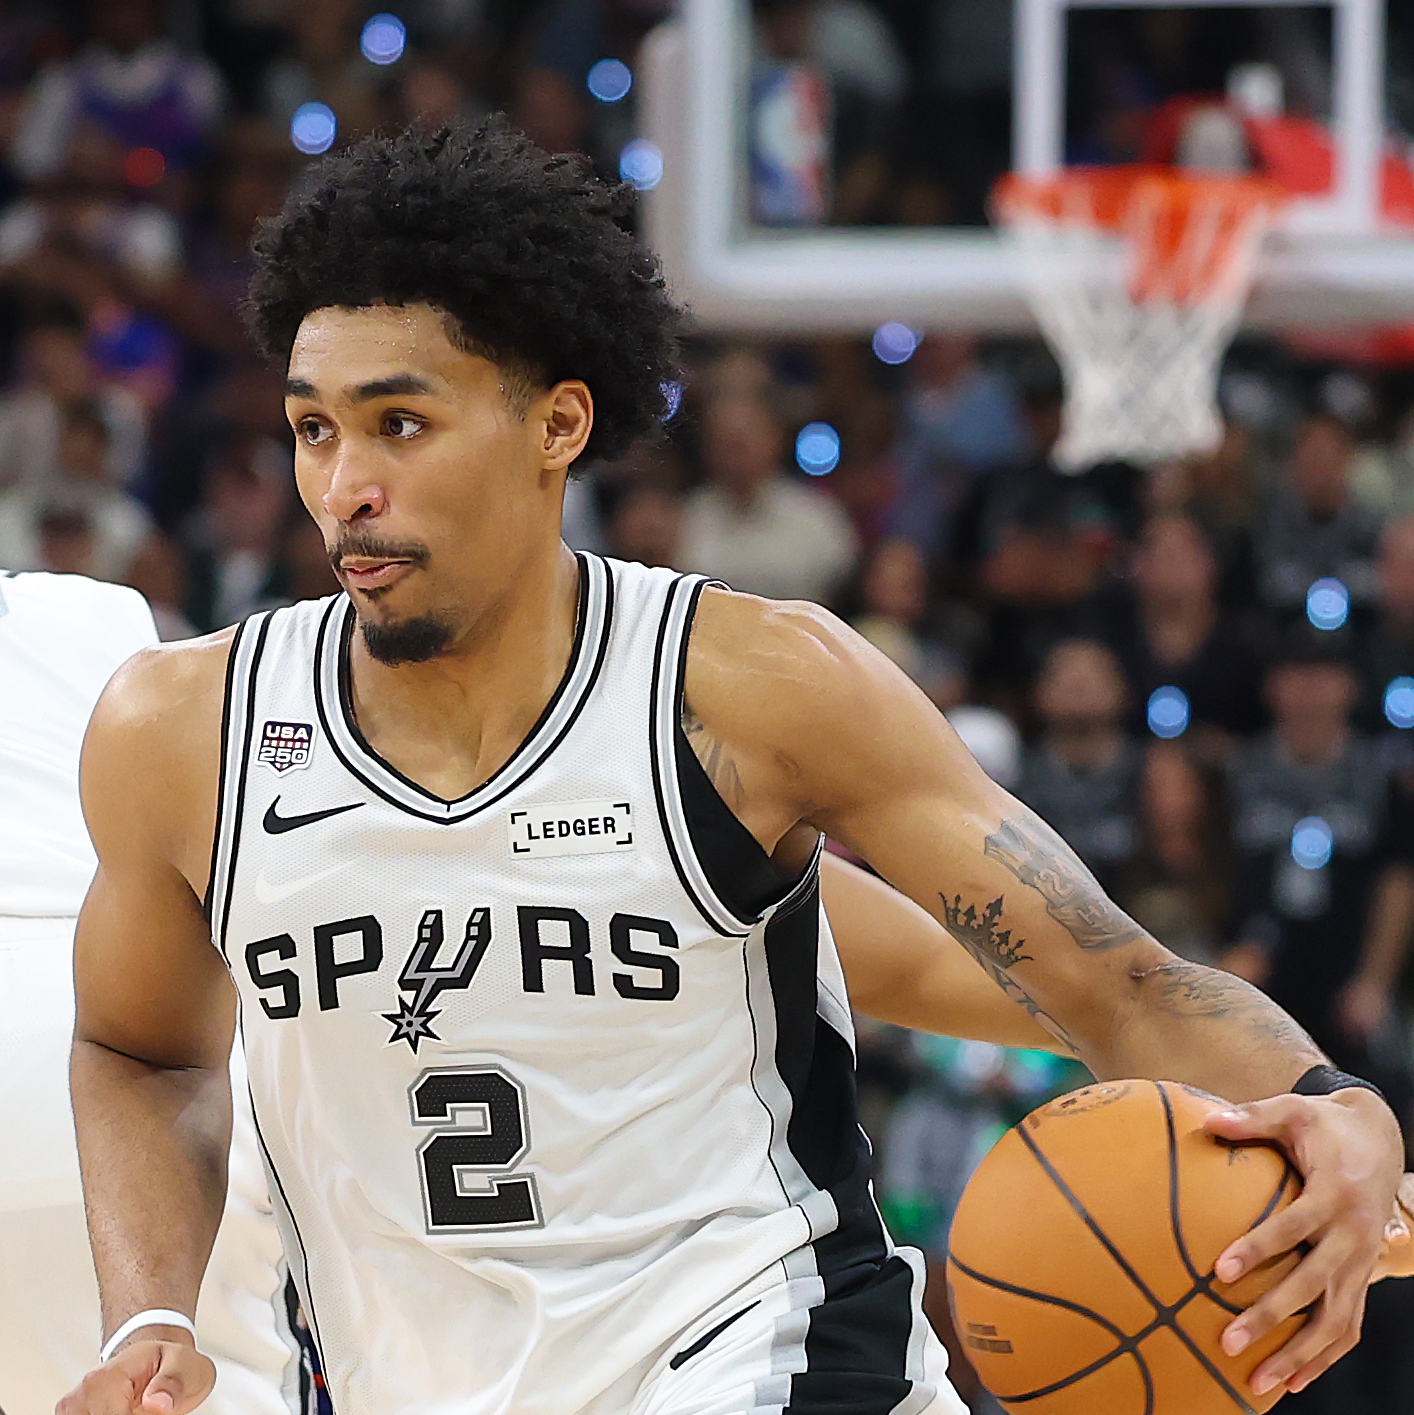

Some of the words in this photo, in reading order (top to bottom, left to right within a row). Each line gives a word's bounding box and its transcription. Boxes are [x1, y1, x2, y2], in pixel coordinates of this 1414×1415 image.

[266, 725, 309, 740] USA
[259, 747, 308, 764] 250
[526, 816, 617, 841] LEDGER
[244, 905, 681, 1056] SPURS
[407, 1063, 546, 1235] 2
